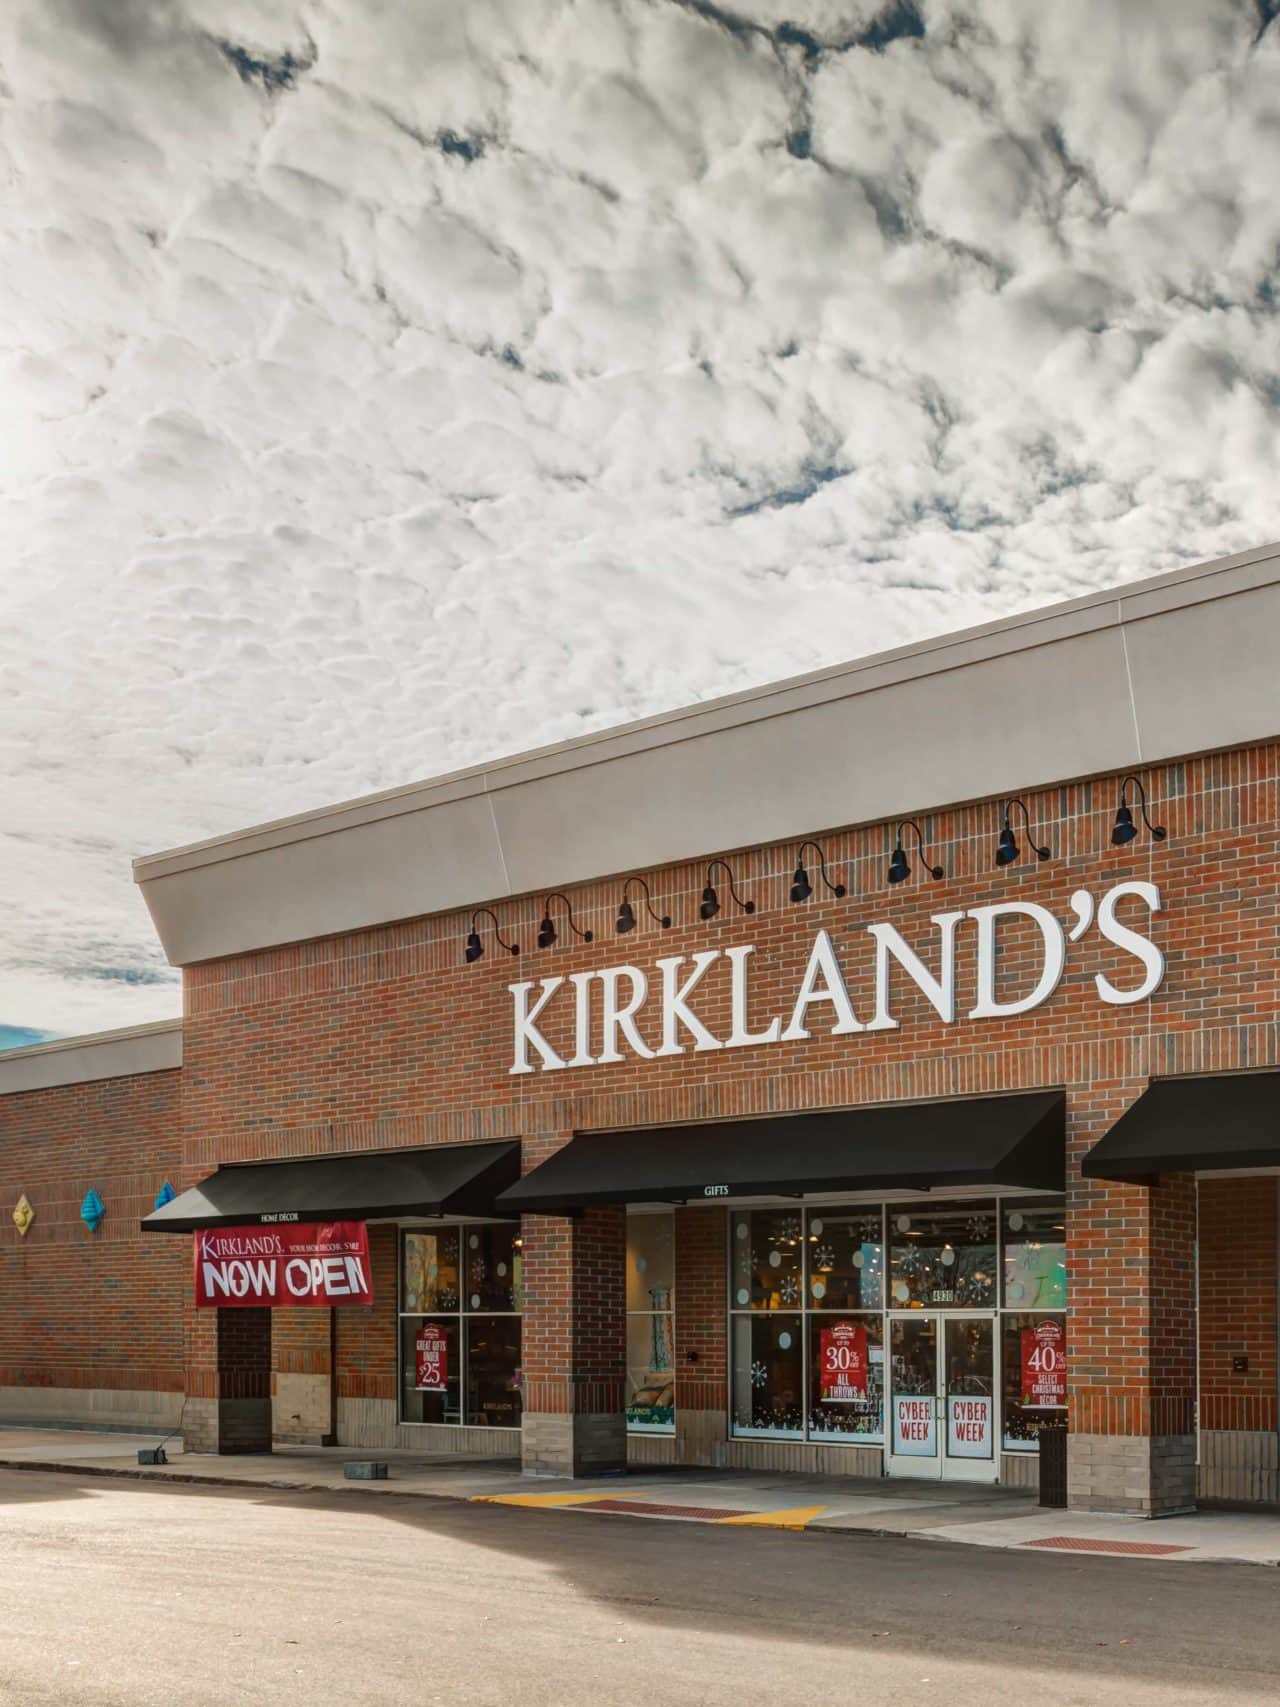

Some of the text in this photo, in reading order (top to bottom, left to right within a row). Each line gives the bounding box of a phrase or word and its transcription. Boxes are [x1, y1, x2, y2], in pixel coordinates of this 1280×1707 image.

[508, 880, 1165, 1075] KIRKLAND'S
[704, 1185, 729, 1196] GIFTS
[202, 1233, 282, 1259] KIRKLAND'S
[202, 1256, 369, 1298] NOW OPEN
[432, 1340, 447, 1352] GIFTS
[419, 1362, 440, 1384] $25
[837, 1373, 849, 1386] ALL
[1038, 1374, 1058, 1385] SELECT
[830, 1385, 858, 1399] THROWS
[1032, 1384, 1065, 1394] CHRISTMAS
[899, 1401, 931, 1421] CYBER
[953, 1402, 987, 1421] CYBER
[901, 1422, 929, 1441] WEEK
[956, 1423, 985, 1442] WEEK
